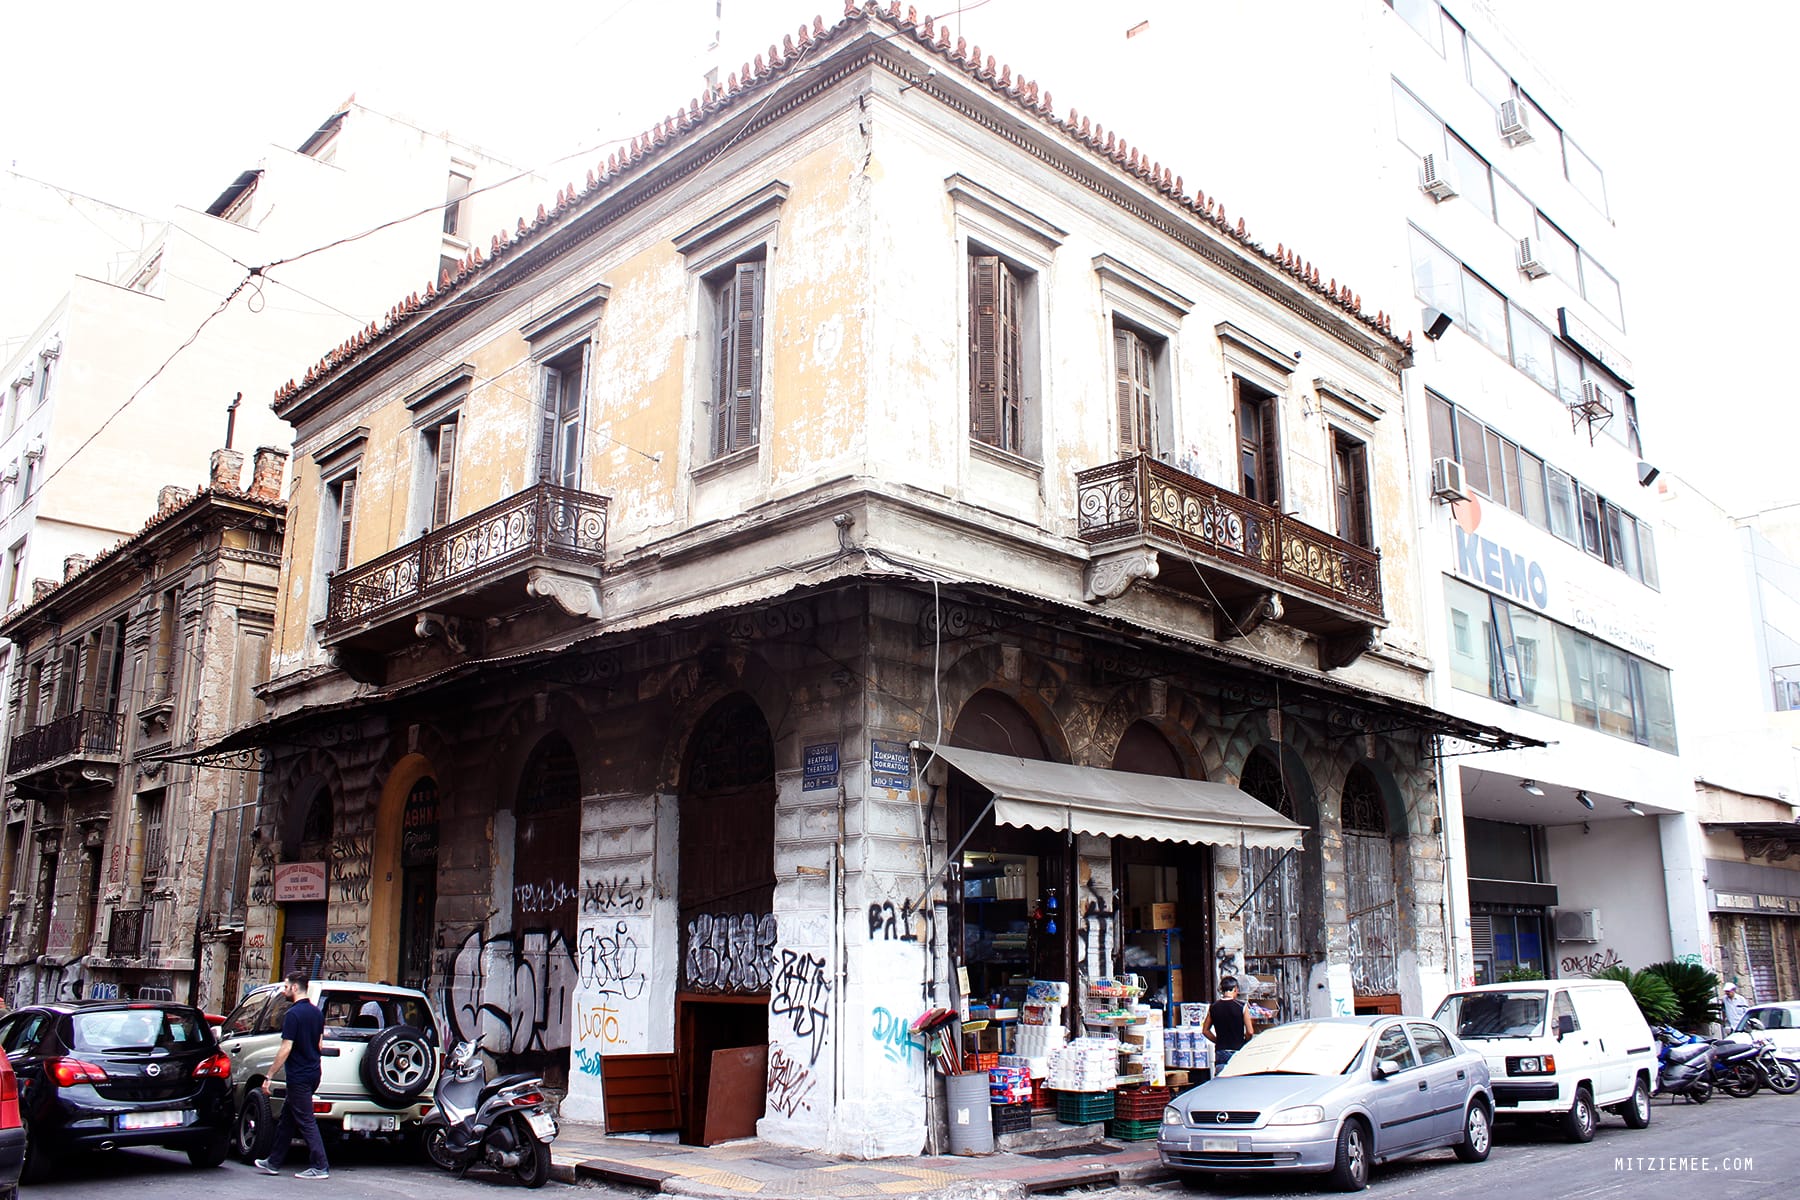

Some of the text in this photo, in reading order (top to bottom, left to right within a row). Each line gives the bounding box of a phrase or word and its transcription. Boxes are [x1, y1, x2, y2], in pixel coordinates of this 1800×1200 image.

[1455, 523, 1548, 610] KEMO
[875, 752, 909, 763] ΣΩΚΡΑΤΟΥΣ
[806, 763, 835, 775] THEATROU
[874, 760, 909, 772] SOKRATOUS
[874, 777, 887, 786] ΑΠΟ
